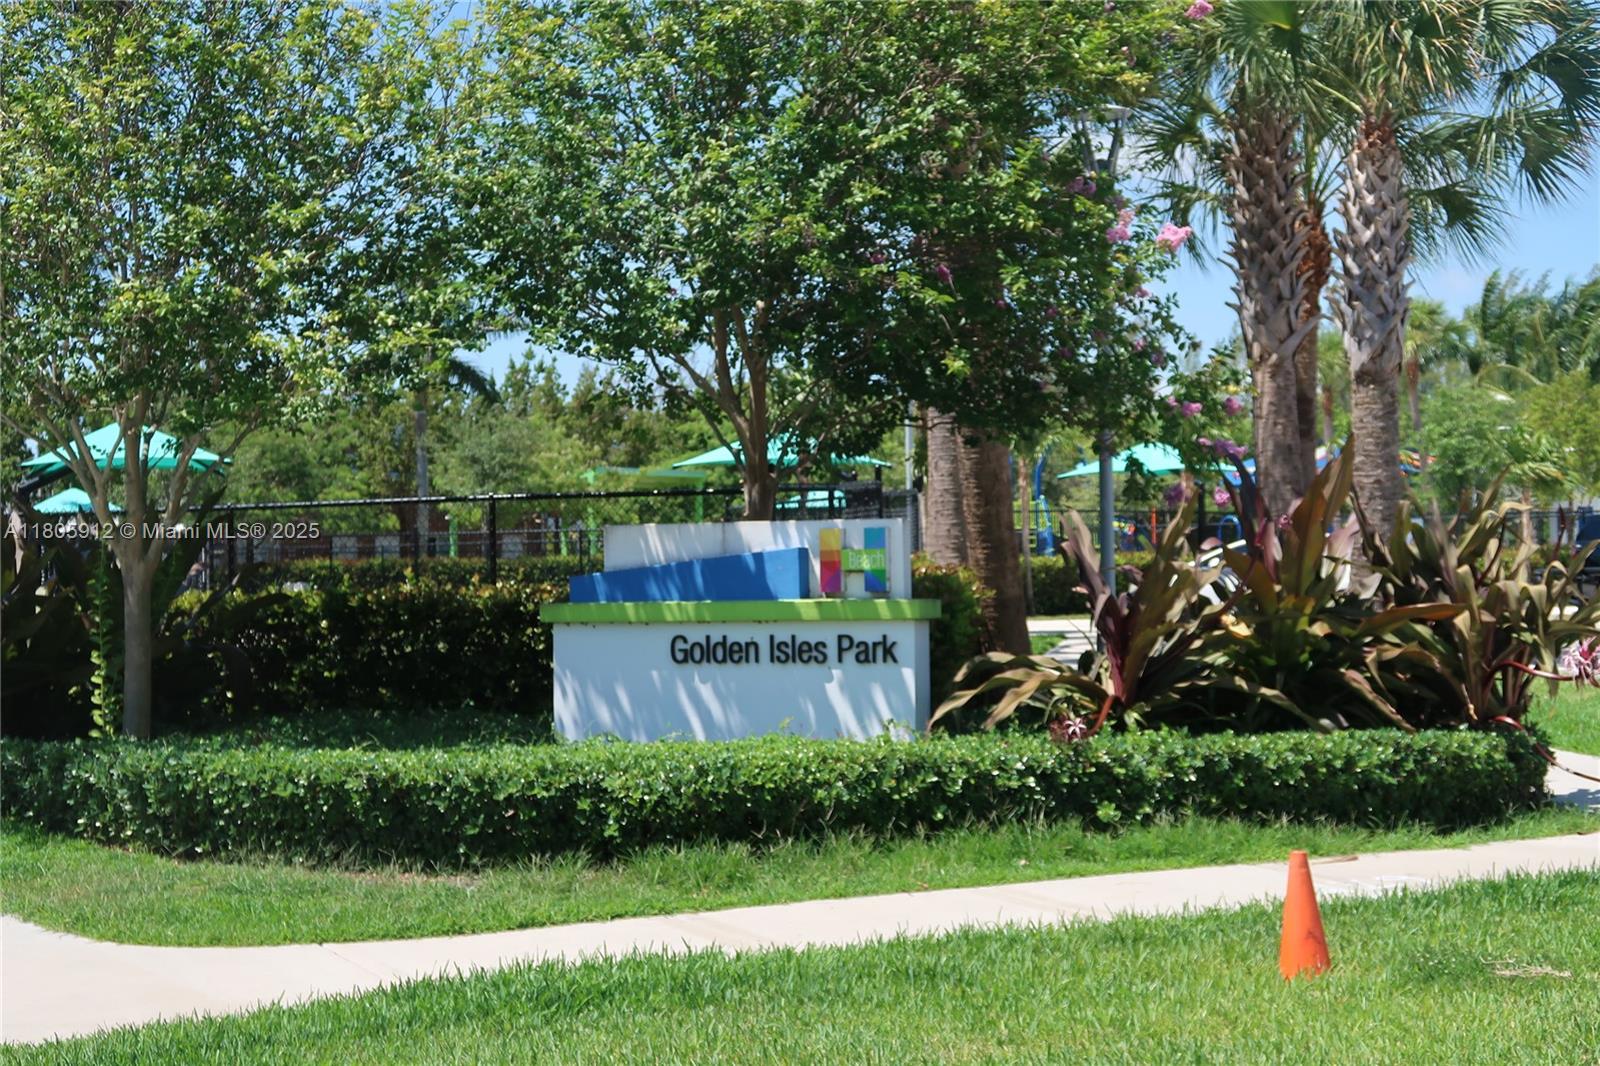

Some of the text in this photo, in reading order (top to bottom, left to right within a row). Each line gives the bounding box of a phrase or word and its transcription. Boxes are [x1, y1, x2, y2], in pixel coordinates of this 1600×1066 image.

[848, 551, 885, 569] Beach
[670, 634, 898, 665] Golden Isles Park
